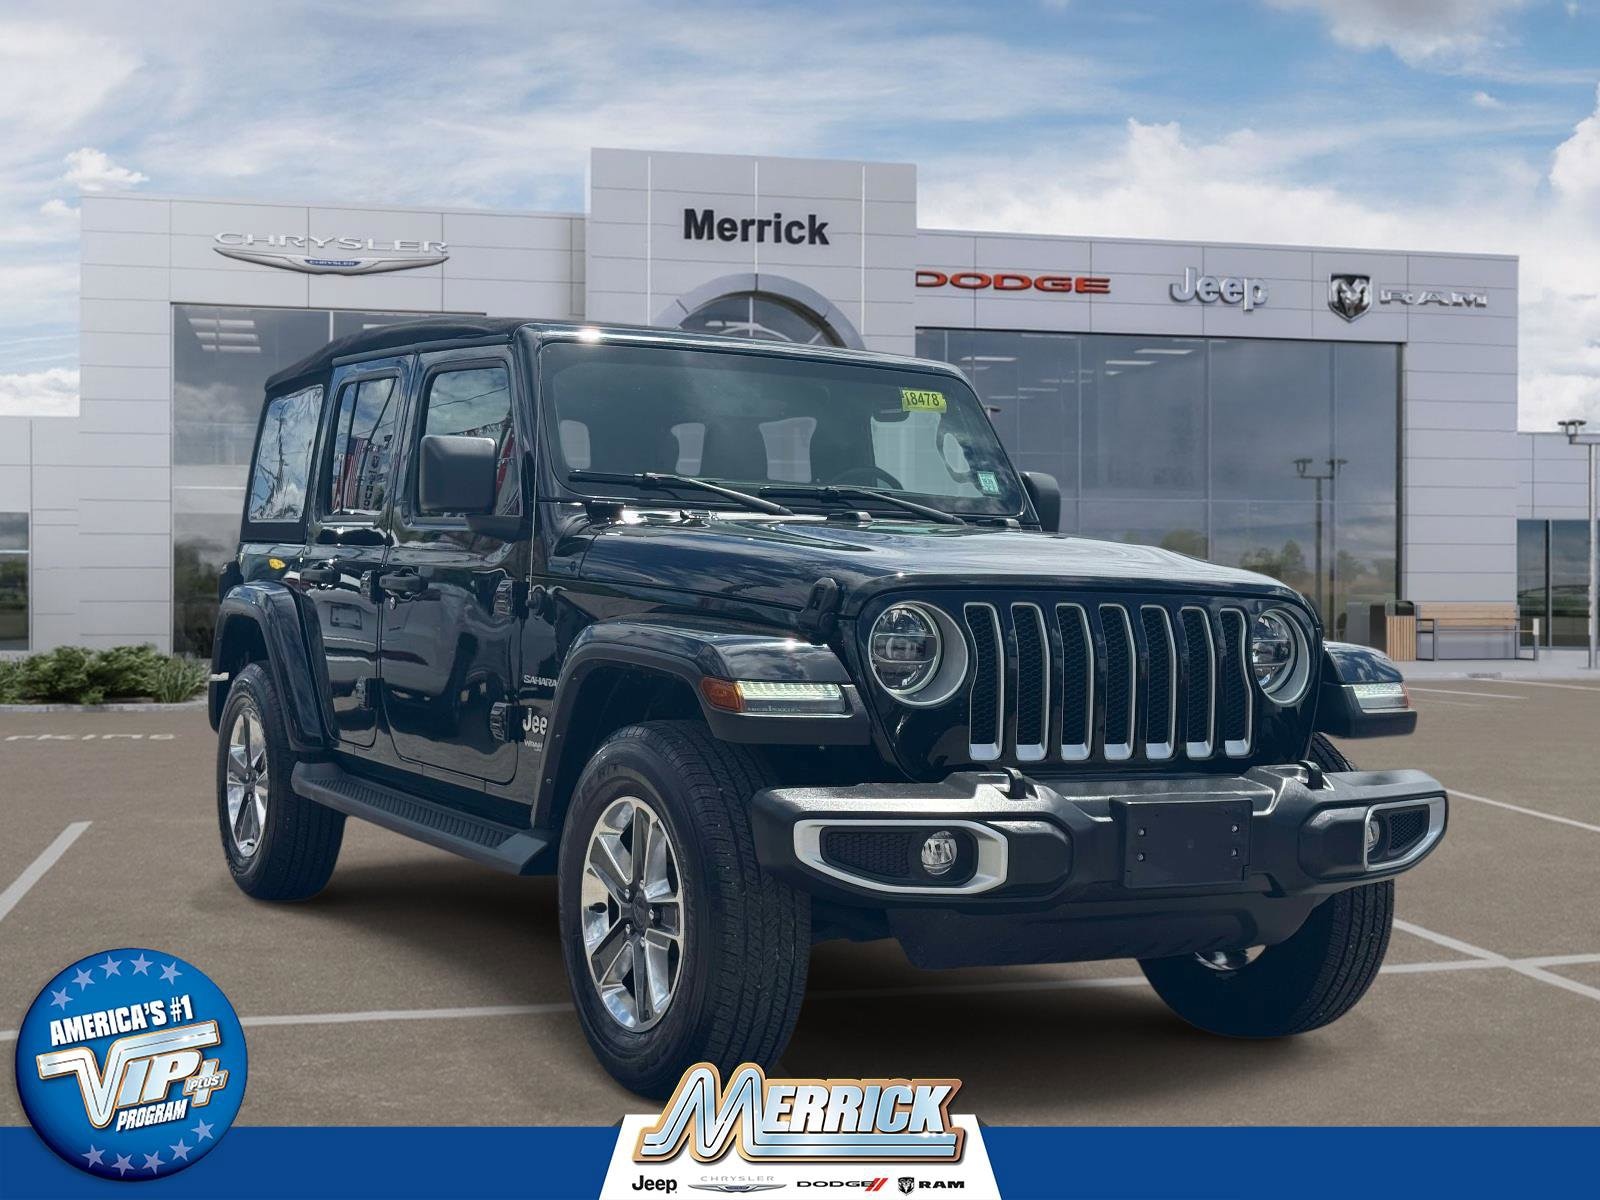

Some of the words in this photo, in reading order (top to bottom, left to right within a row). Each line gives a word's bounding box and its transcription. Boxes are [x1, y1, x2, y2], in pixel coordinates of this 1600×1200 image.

[683, 208, 830, 245] Merrick
[214, 232, 449, 253] CHRYSLER
[915, 271, 1111, 294] DODGE
[1169, 266, 1269, 312] Jeep
[1379, 289, 1488, 308] RAM
[904, 391, 941, 407] 18478
[523, 674, 558, 688] SAHARA
[522, 707, 548, 735] Jee
